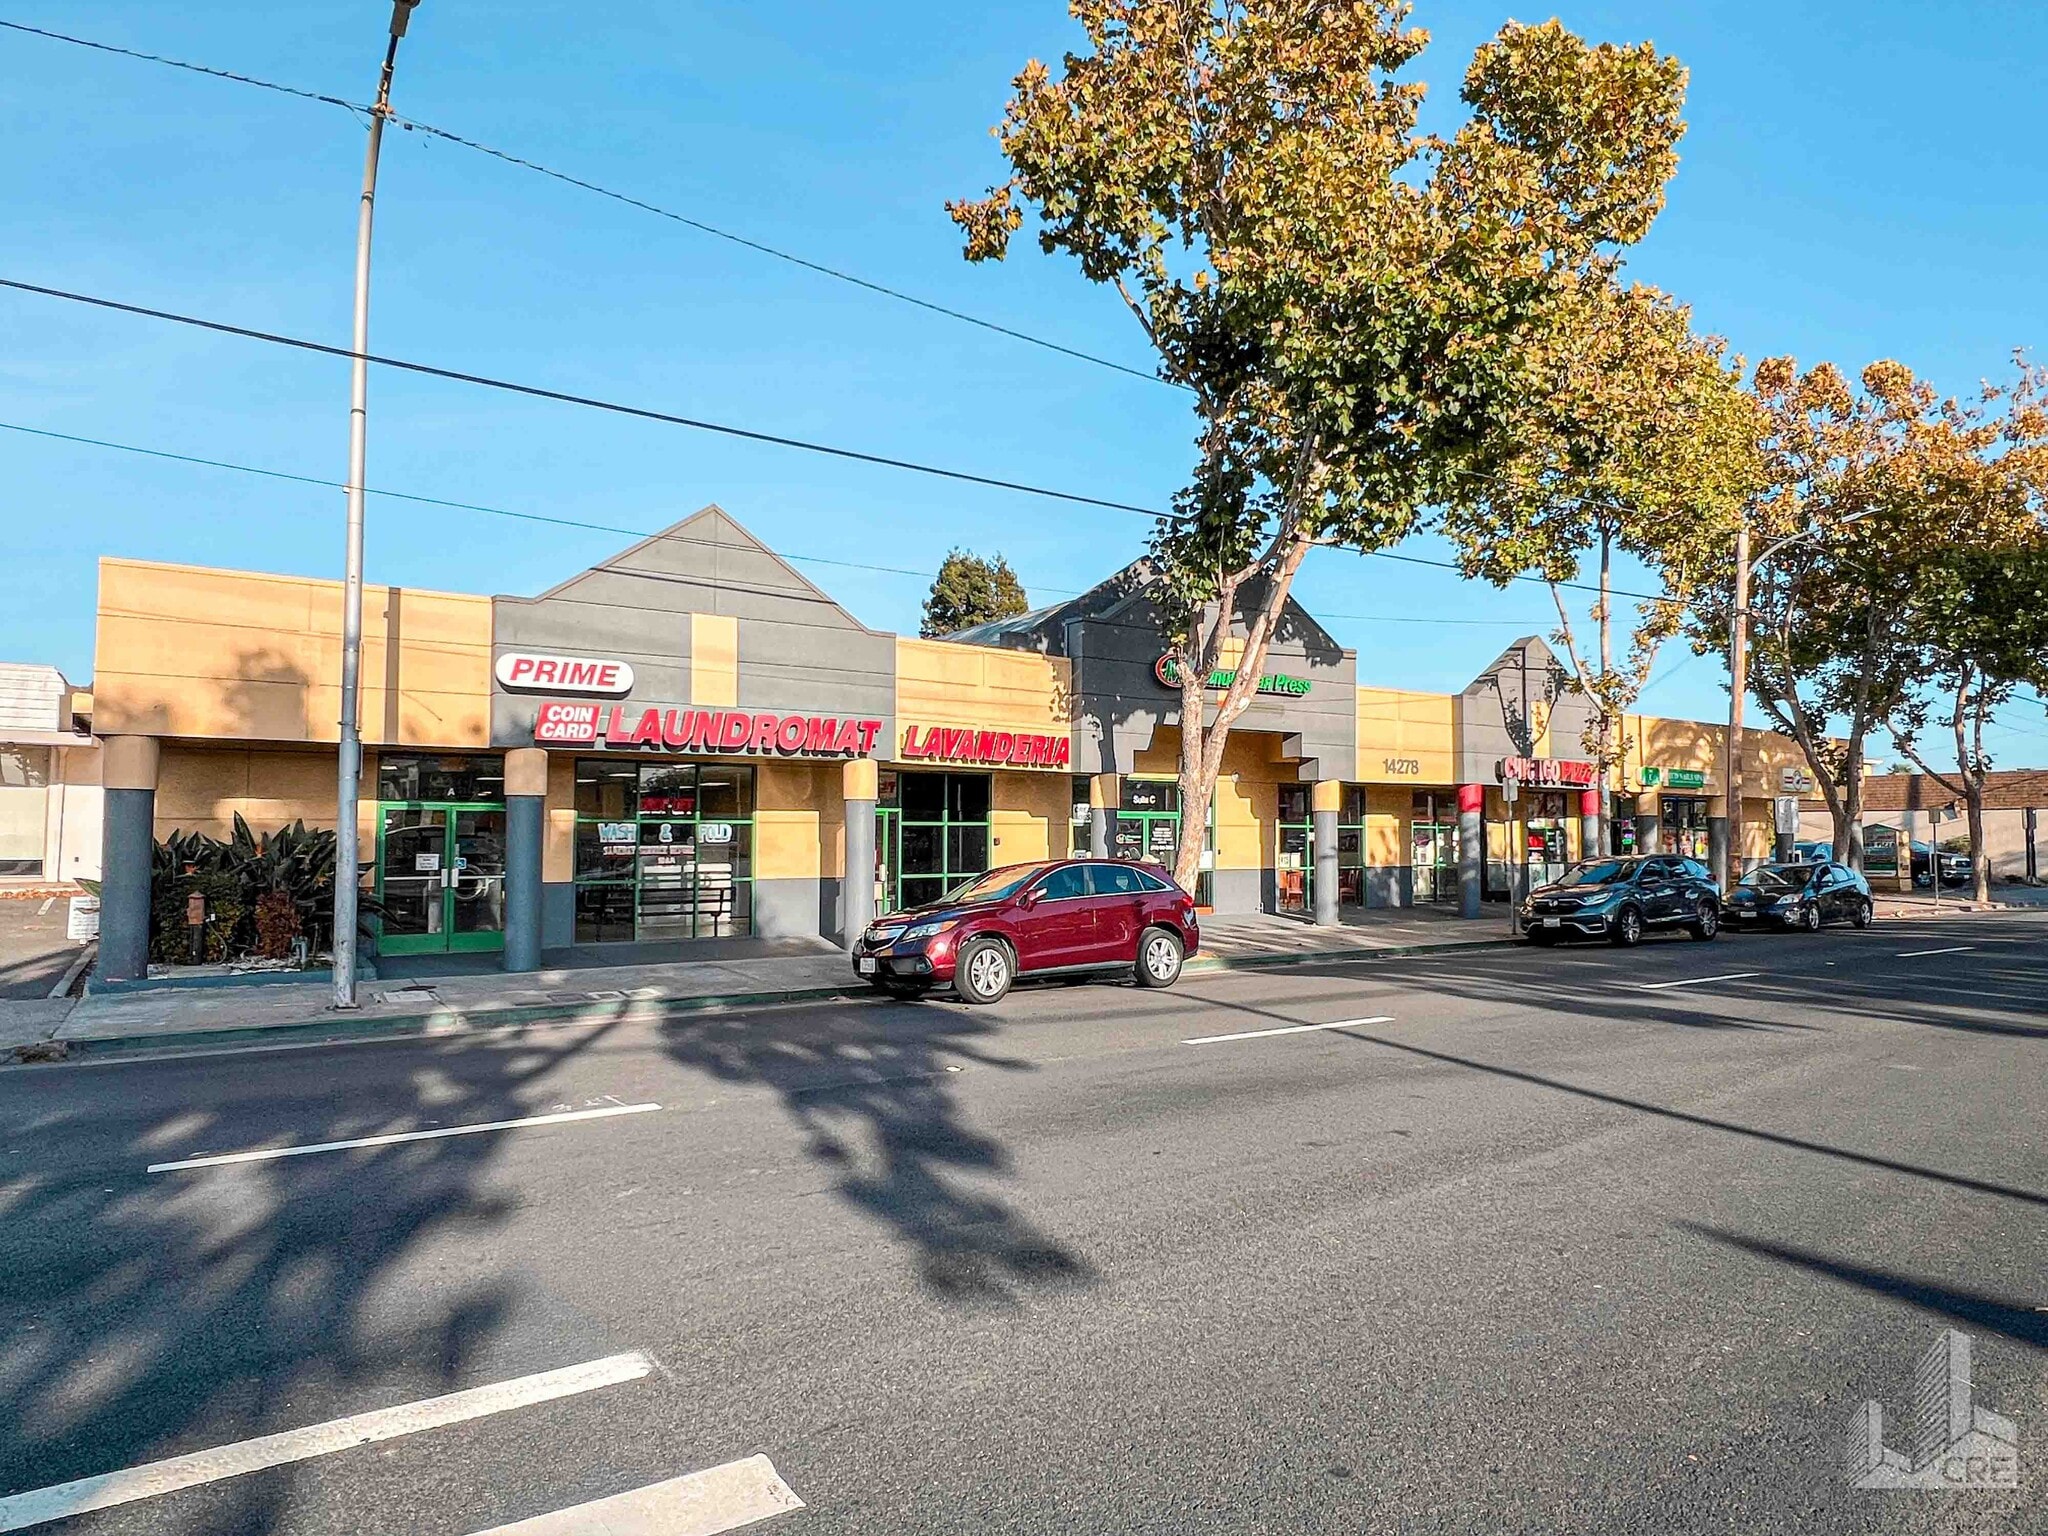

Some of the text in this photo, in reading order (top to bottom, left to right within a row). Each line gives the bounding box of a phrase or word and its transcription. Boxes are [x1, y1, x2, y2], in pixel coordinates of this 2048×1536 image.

[510, 658, 621, 688] PRIME
[1206, 670, 1271, 691] inutan
[1276, 673, 1312, 694] Press
[547, 704, 593, 723] COIN
[540, 721, 593, 740] CARD
[605, 706, 883, 755] LAUNDROMAT
[902, 725, 1070, 766] LAVANDERIA
[1382, 759, 1420, 775] 14278
[447, 787, 456, 796] A
[1148, 795, 1157, 805] C
[598, 823, 733, 844] WASH & FOLD
